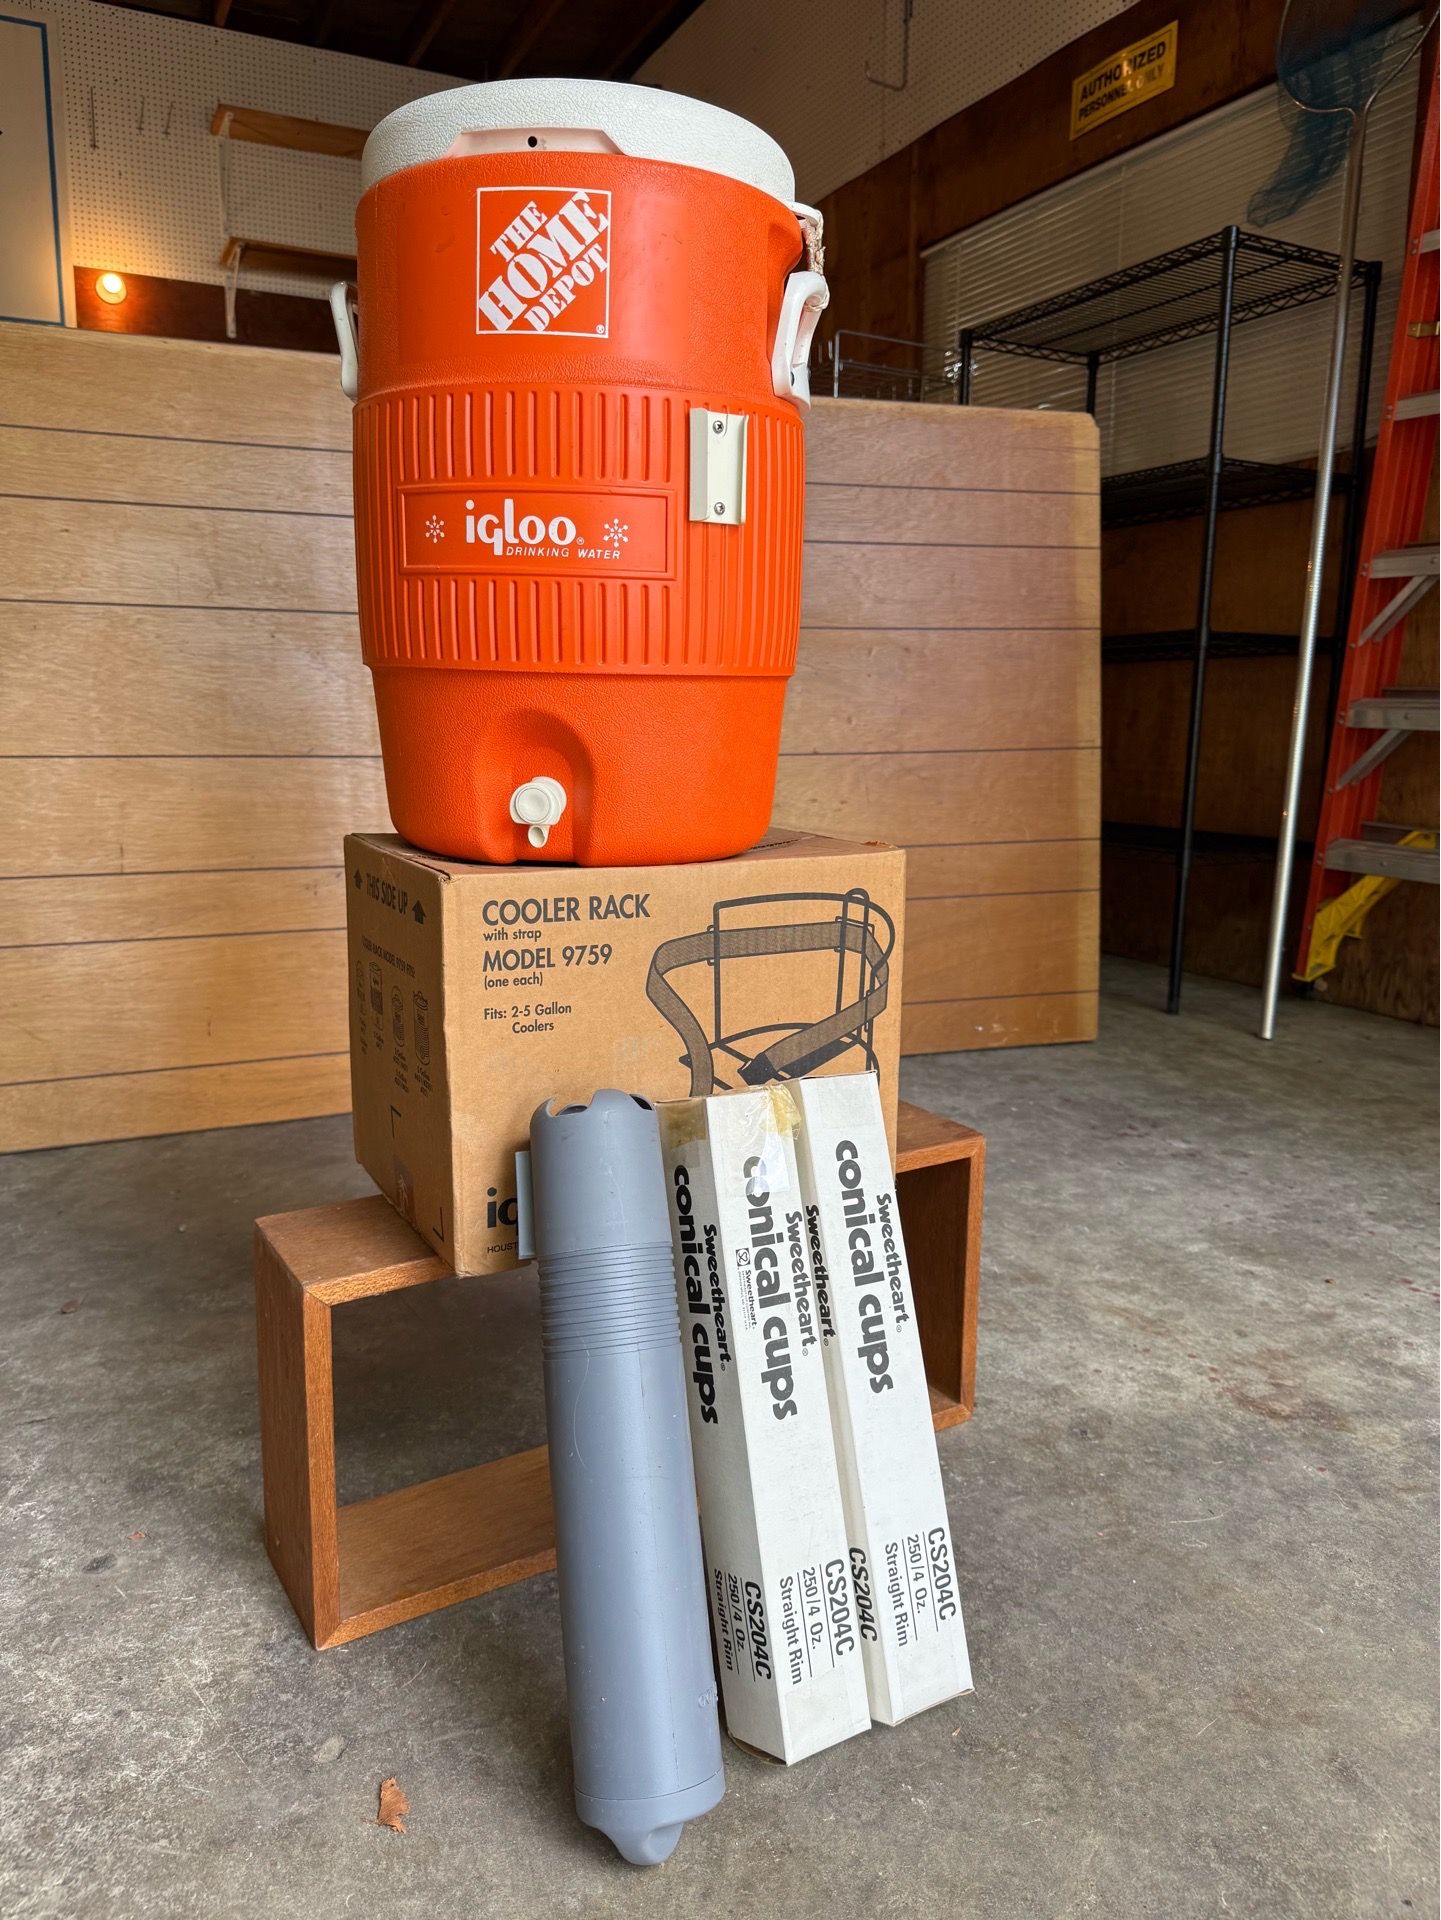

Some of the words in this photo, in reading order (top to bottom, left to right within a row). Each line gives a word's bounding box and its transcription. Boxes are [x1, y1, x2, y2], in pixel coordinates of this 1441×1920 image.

[1078, 79, 1134, 120] PERSONNEL
[1081, 41, 1166, 99] AUTHORIZED
[478, 191, 609, 331] HOME
[490, 201, 548, 262] THE
[524, 243, 609, 331] DEPOT
[465, 498, 577, 556] igloo
[506, 546, 570, 557] DRINKING
[578, 548, 621, 560] WATER
[366, 873, 380, 901] THIS
[381, 881, 396, 910] SIDE
[398, 891, 408, 915] UP
[482, 897, 581, 926] COOLER
[589, 894, 651, 920] RACK
[482, 947, 556, 972] MODEL
[562, 944, 613, 966] 9759
[483, 927, 509, 941] with
[512, 929, 542, 942] strap
[484, 974, 509, 990] (one
[513, 972, 543, 987] each)
[484, 1007, 507, 1020] Fits:
[511, 1005, 531, 1018] 2-5
[535, 1001, 572, 1016] Gallon
[512, 1019, 554, 1033] Coolers
[674, 1164, 711, 1315] conical
[743, 1155, 792, 1309] conical
[835, 1139, 885, 1287] conical
[703, 1223, 732, 1363] Sweetheart
[785, 1210, 818, 1347] Sweetheart
[806, 1204, 837, 1338] Sweetheart
[877, 1193, 910, 1323] Sweetheart
[745, 1269, 757, 1326] Sweetheart
[692, 1322, 719, 1425] cups
[761, 1316, 798, 1421] cups
[857, 1294, 894, 1394] cups
[802, 1566, 821, 1617] 250/4
[848, 1547, 878, 1642] CS204C
[885, 1542, 905, 1611] Straight
[895, 1611, 910, 1647] Rim
[907, 1534, 925, 1582] 250/4
[928, 1526, 957, 1621] CS204C
[714, 1568, 729, 1639] Straight
[723, 1637, 734, 1671] Rim
[727, 1573, 743, 1622] 250/4
[735, 1628, 746, 1652] Oz.
[744, 1581, 772, 1680] CS204C
[779, 1575, 800, 1648] Straight
[810, 1621, 824, 1650] Oz.
[825, 1558, 855, 1656] CS204C
[915, 1587, 928, 1614] Oz.
[789, 1648, 804, 1685] Rim
